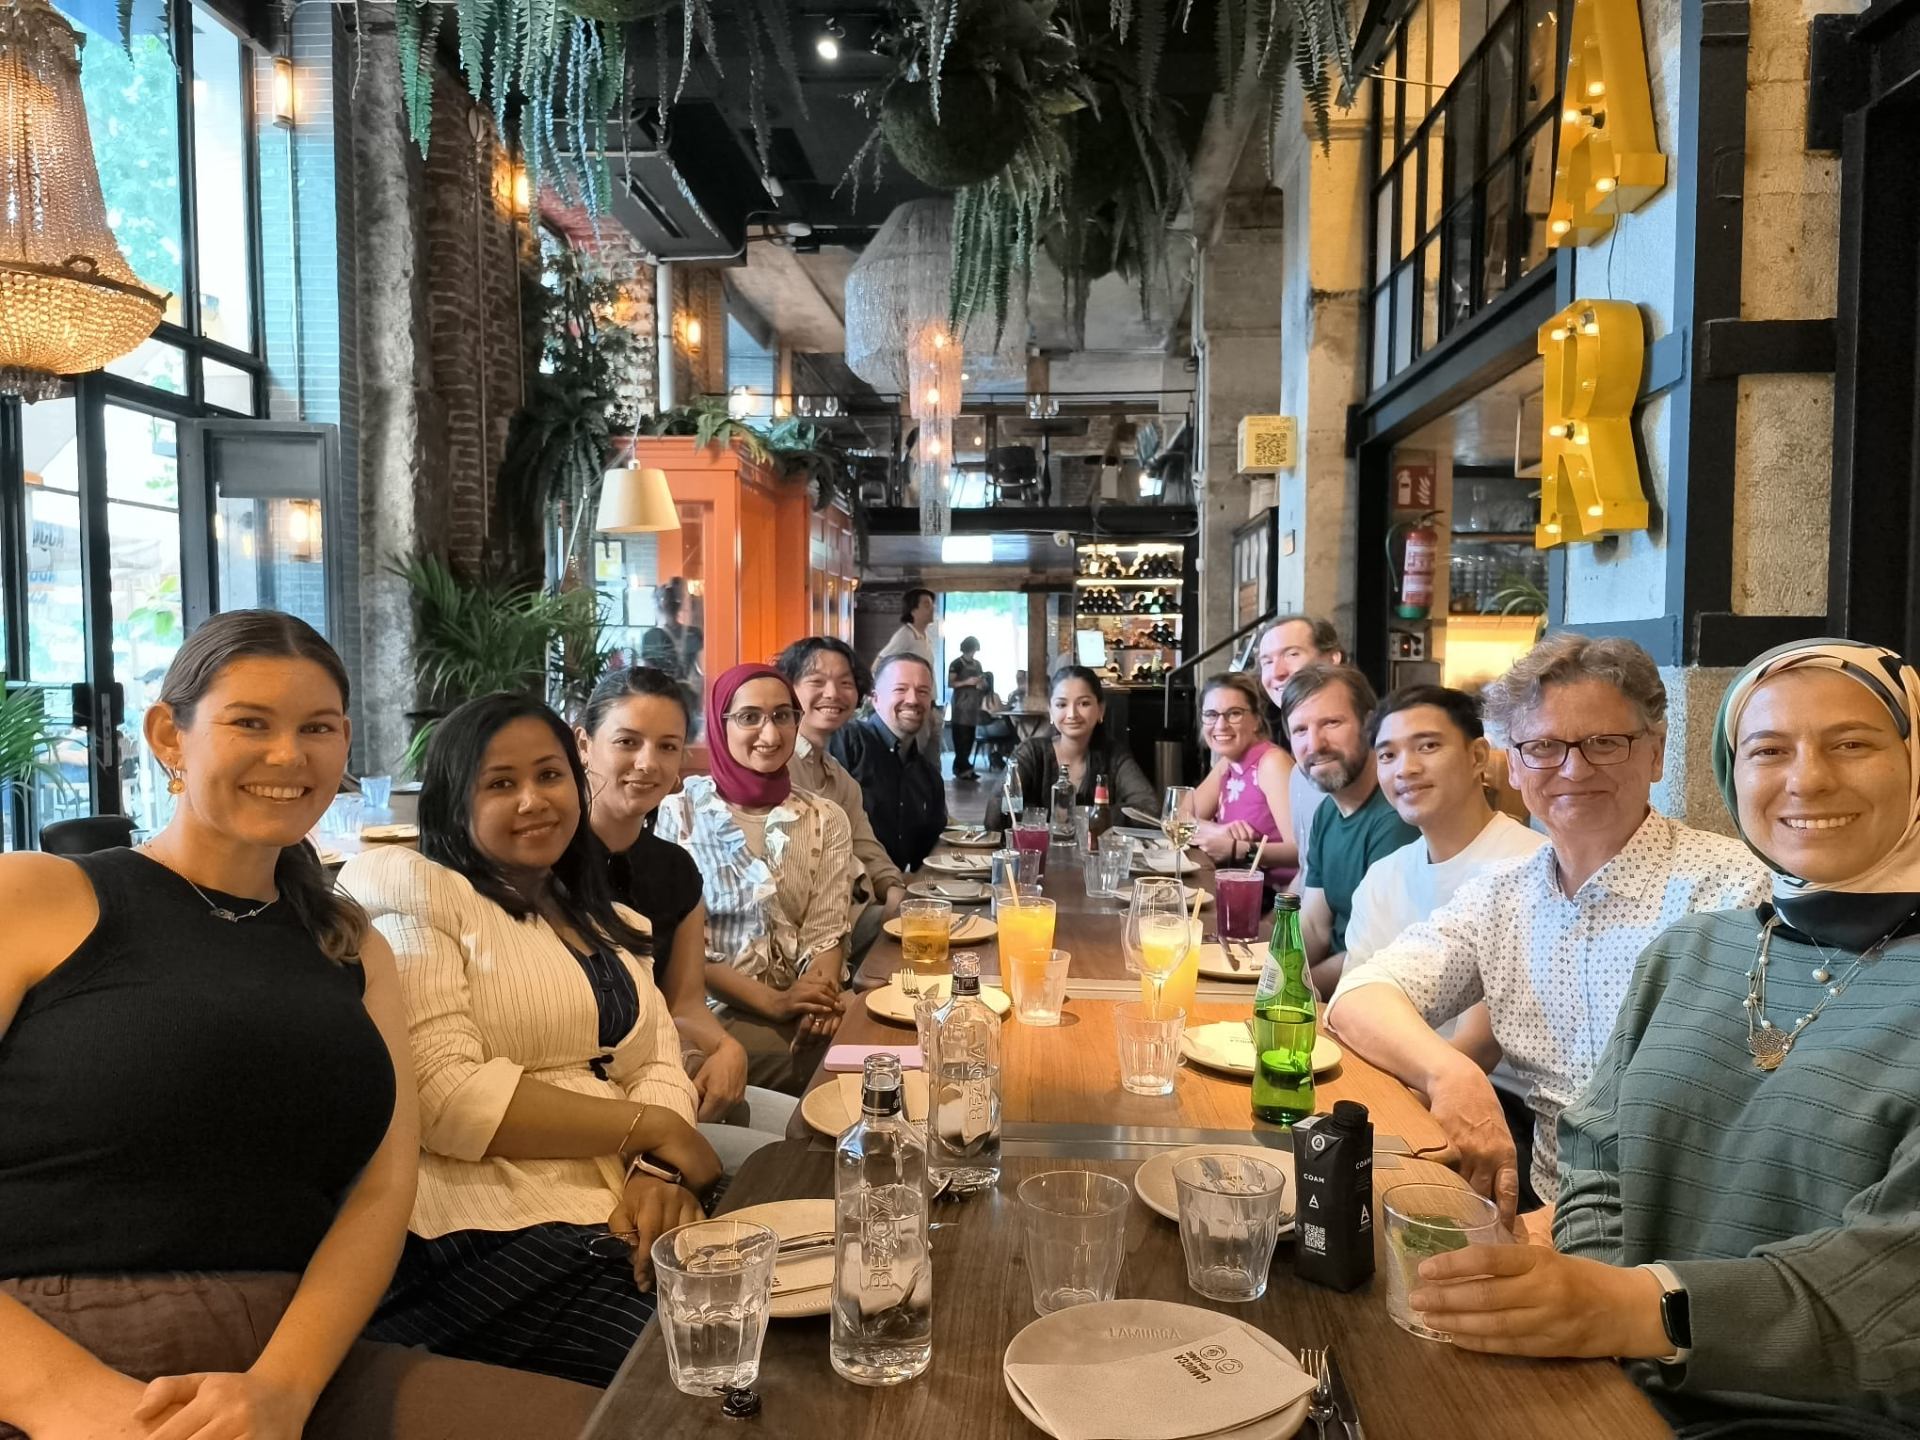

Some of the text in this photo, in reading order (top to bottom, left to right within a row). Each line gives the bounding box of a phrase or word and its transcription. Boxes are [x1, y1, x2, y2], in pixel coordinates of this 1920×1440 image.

[968, 1043, 986, 1121] BEZOYA
[1303, 1173, 1325, 1183] COAM
[870, 1185, 893, 1287] BEZOYA
[1173, 1354, 1212, 1384] LAMUCCA
